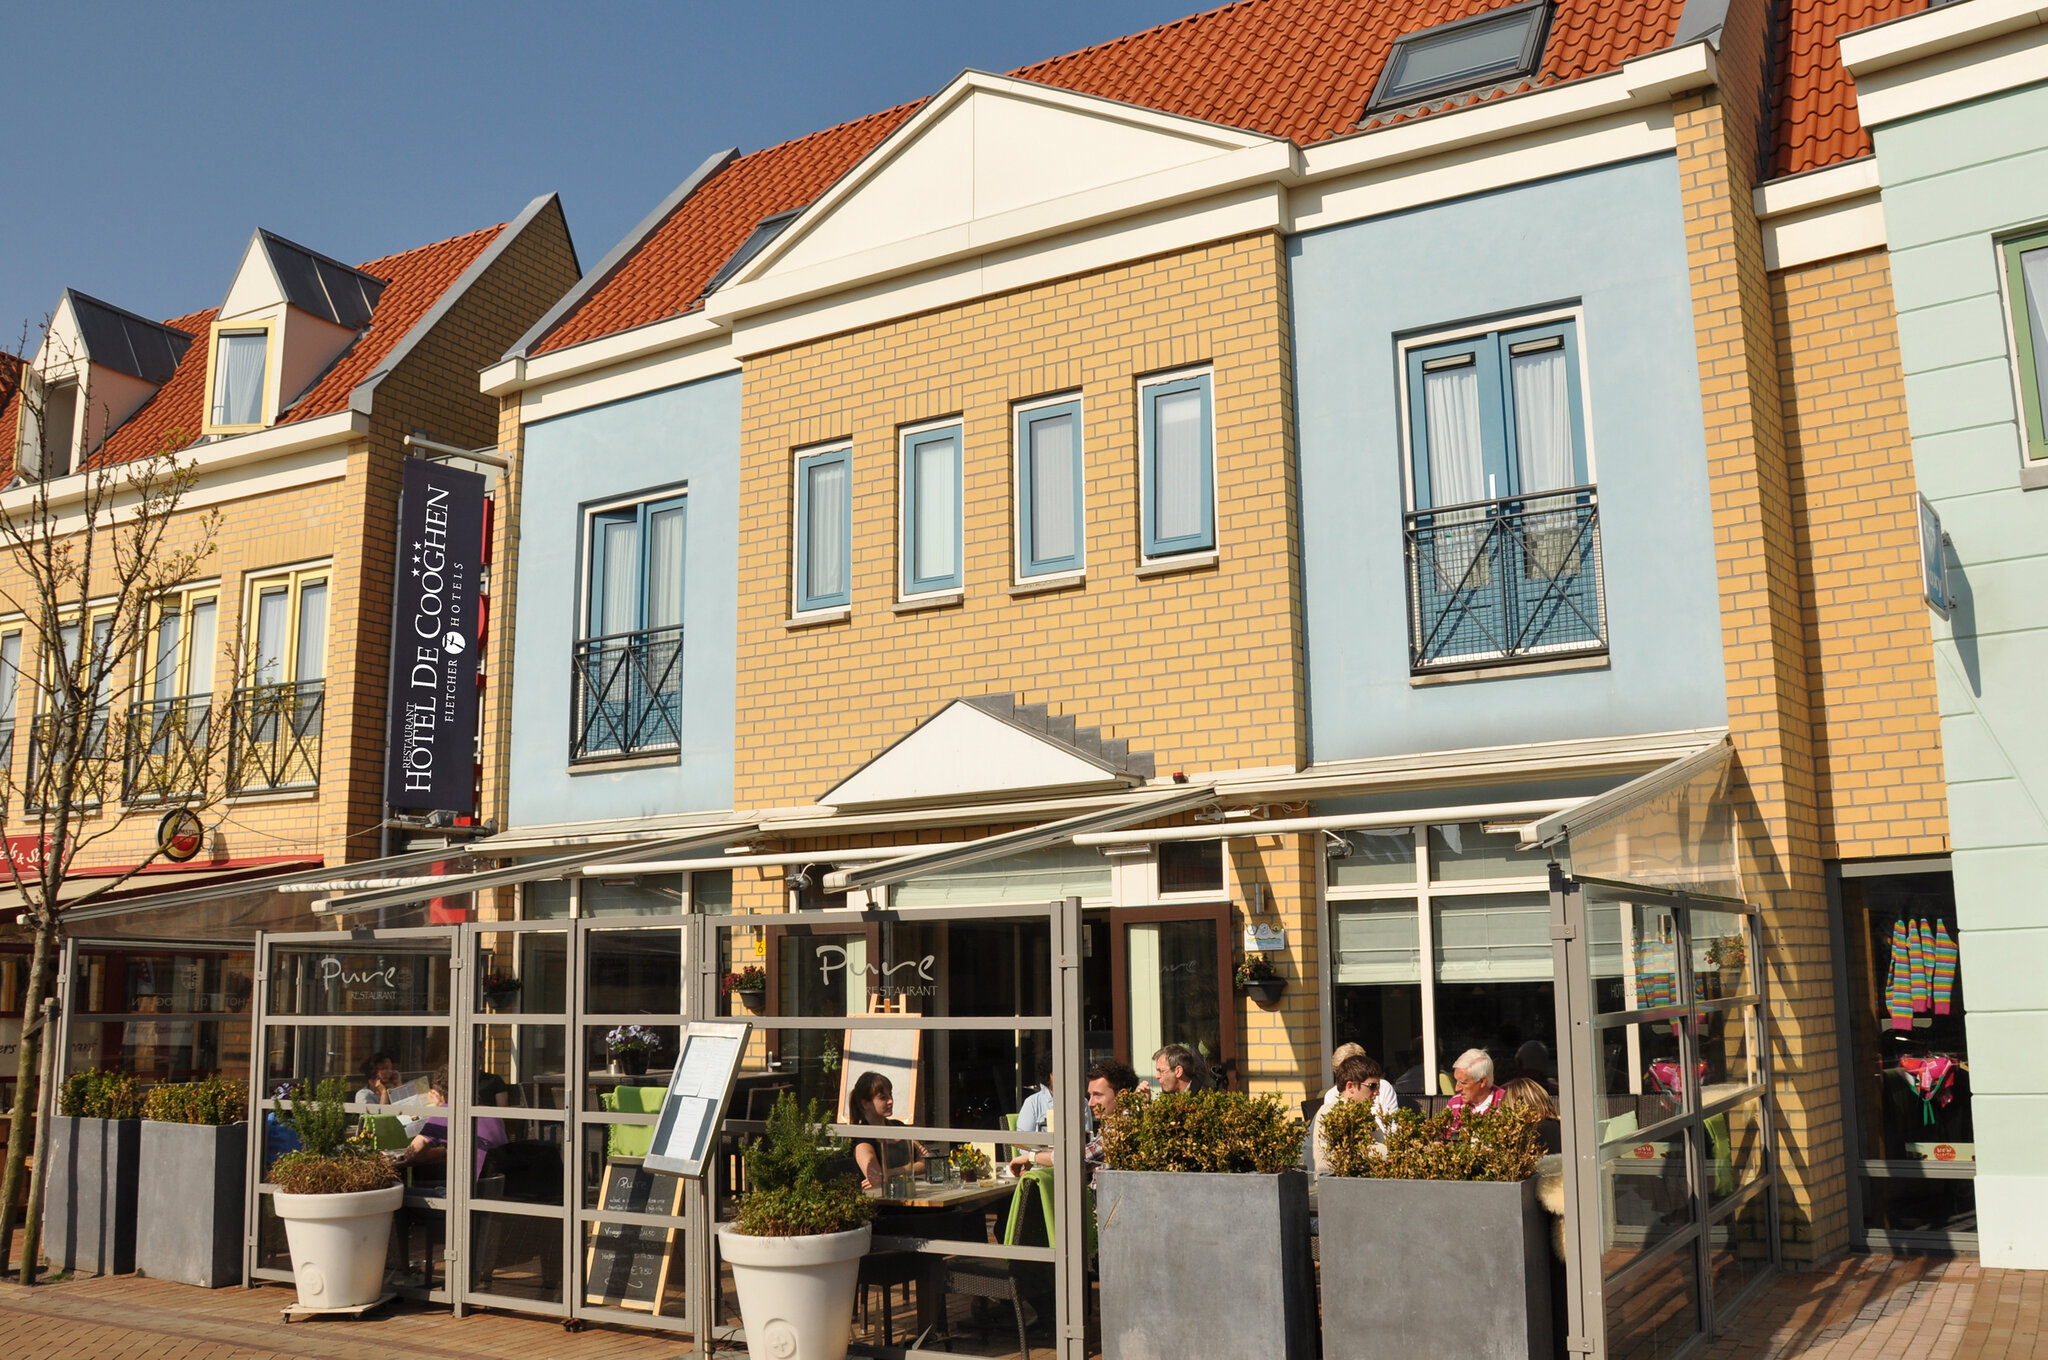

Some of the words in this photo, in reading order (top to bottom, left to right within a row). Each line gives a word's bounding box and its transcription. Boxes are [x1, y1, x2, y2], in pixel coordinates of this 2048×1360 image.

[414, 484, 449, 639] COOGHEN
[450, 562, 464, 627] HOTELS
[410, 645, 439, 690] DE
[445, 659, 458, 722] FLETCHER
[402, 702, 415, 768] RESTAURANT
[404, 696, 437, 792] HOTEL
[757, 943, 764, 954] 6
[815, 944, 936, 987] Pure
[321, 957, 396, 992] Pure
[351, 991, 398, 1001] RESTAURANT
[865, 985, 939, 996] RESTAURANT
